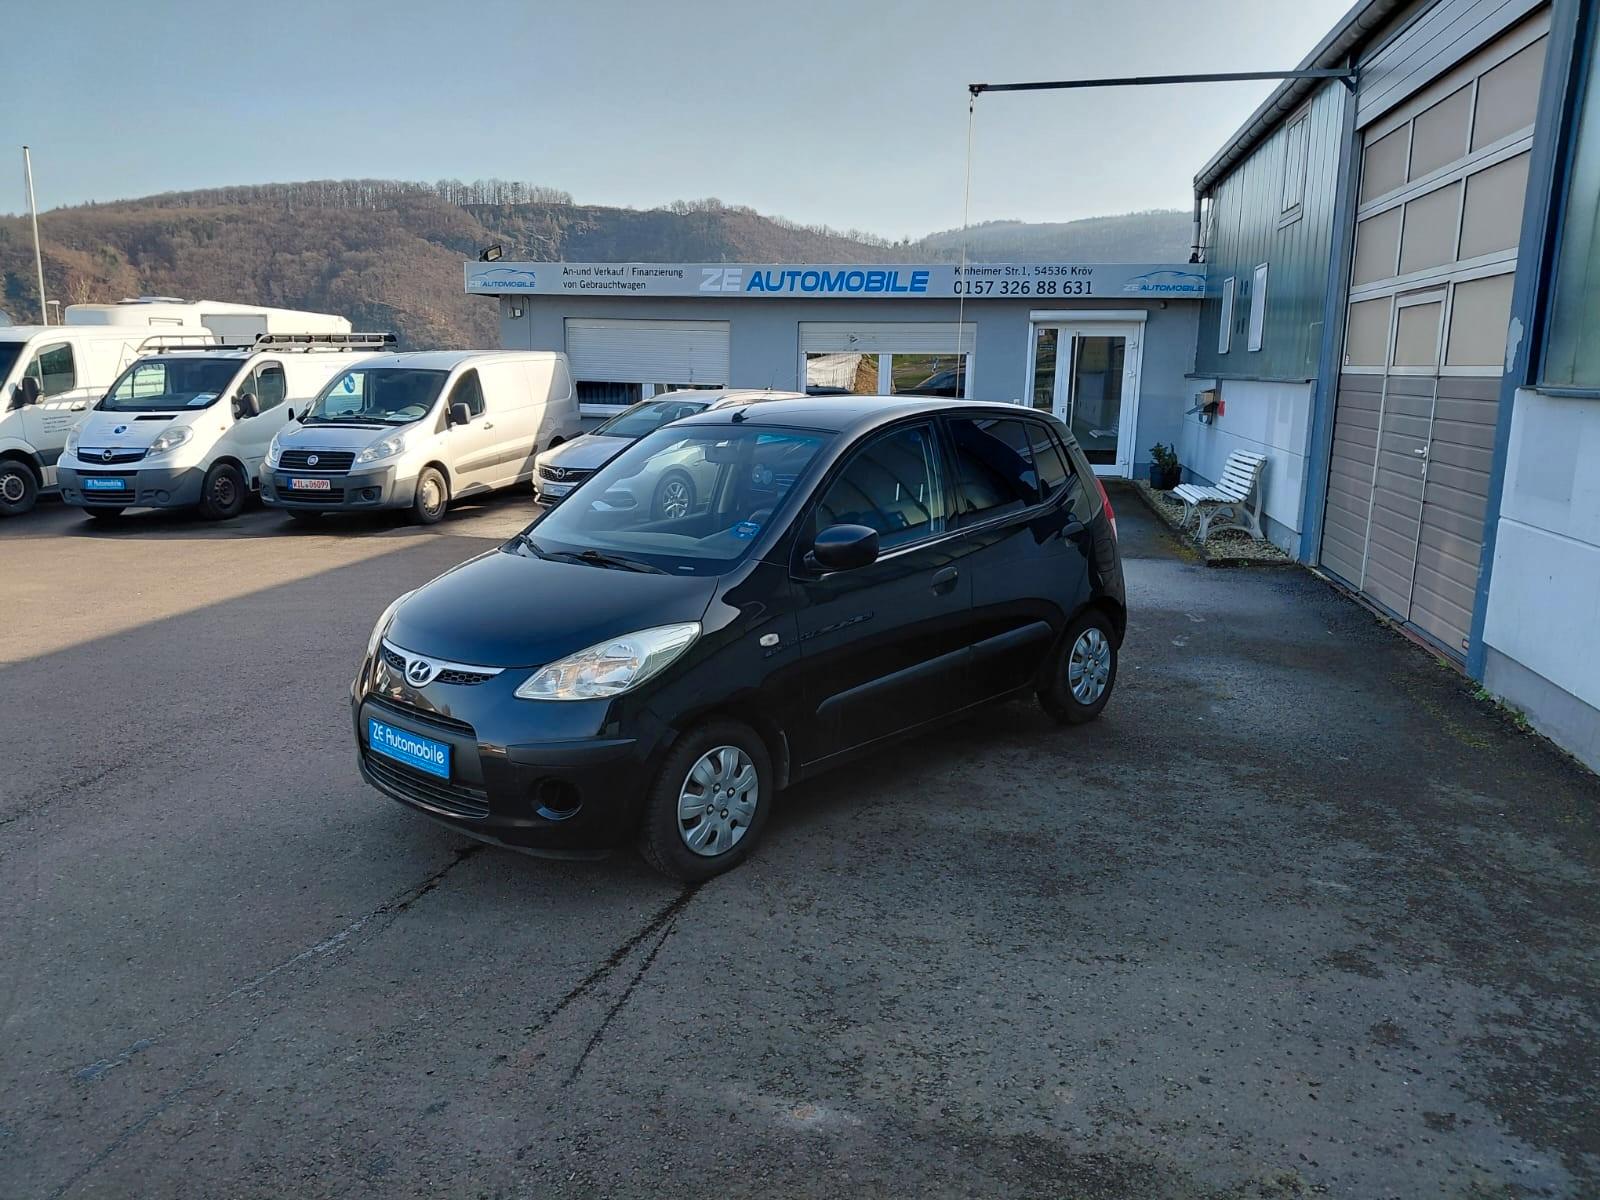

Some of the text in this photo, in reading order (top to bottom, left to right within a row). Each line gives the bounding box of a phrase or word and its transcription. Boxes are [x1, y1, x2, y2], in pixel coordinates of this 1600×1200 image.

[594, 266, 625, 276] Verkauf
[632, 266, 684, 279] Finanzierung
[953, 266, 1002, 276] Knheimer
[1034, 266, 1068, 276] 54536
[1070, 266, 1094, 276] Kröv
[562, 280, 647, 291] von Gebrauchtwagen
[699, 268, 930, 293] ZE AUTOMOBILE
[953, 280, 1093, 295] 0157 326 88 631
[1140, 284, 1204, 292] AUTOMOBILE
[372, 722, 385, 742] ZE
[385, 727, 445, 764] Automobile
